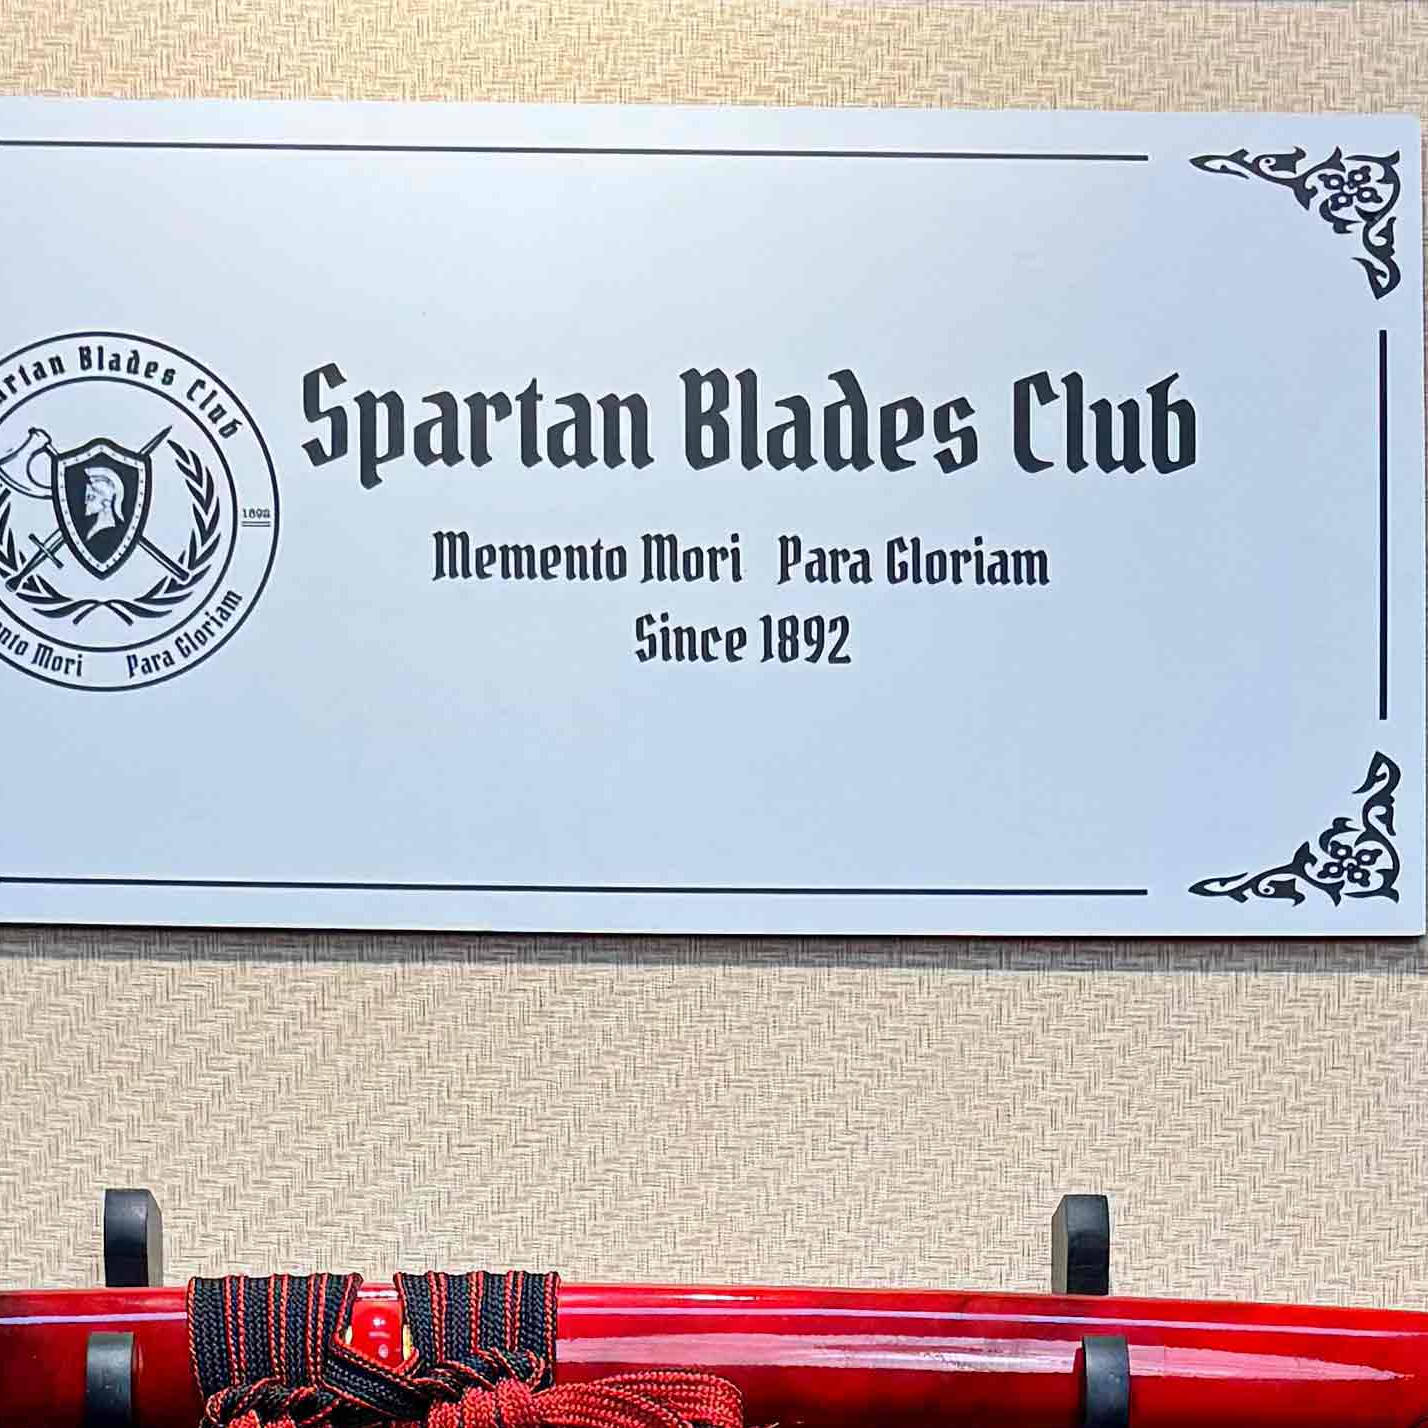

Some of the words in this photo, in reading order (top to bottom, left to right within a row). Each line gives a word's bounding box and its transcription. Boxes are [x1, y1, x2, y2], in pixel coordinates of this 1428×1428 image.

[78, 346, 176, 386] Blades
[186, 379, 243, 439] Club
[302, 363, 654, 488] Spartan
[680, 368, 977, 473] Blades
[1014, 371, 1196, 474] Club
[433, 531, 627, 581] Memento
[641, 533, 743, 583] Mori
[778, 536, 873, 585] Para
[887, 536, 1050, 586] Gloriam
[32, 642, 83, 677] Mori
[126, 649, 175, 678] Para
[175, 590, 243, 652] Gloriam
[636, 613, 747, 662] Since
[760, 615, 852, 664] 1892
